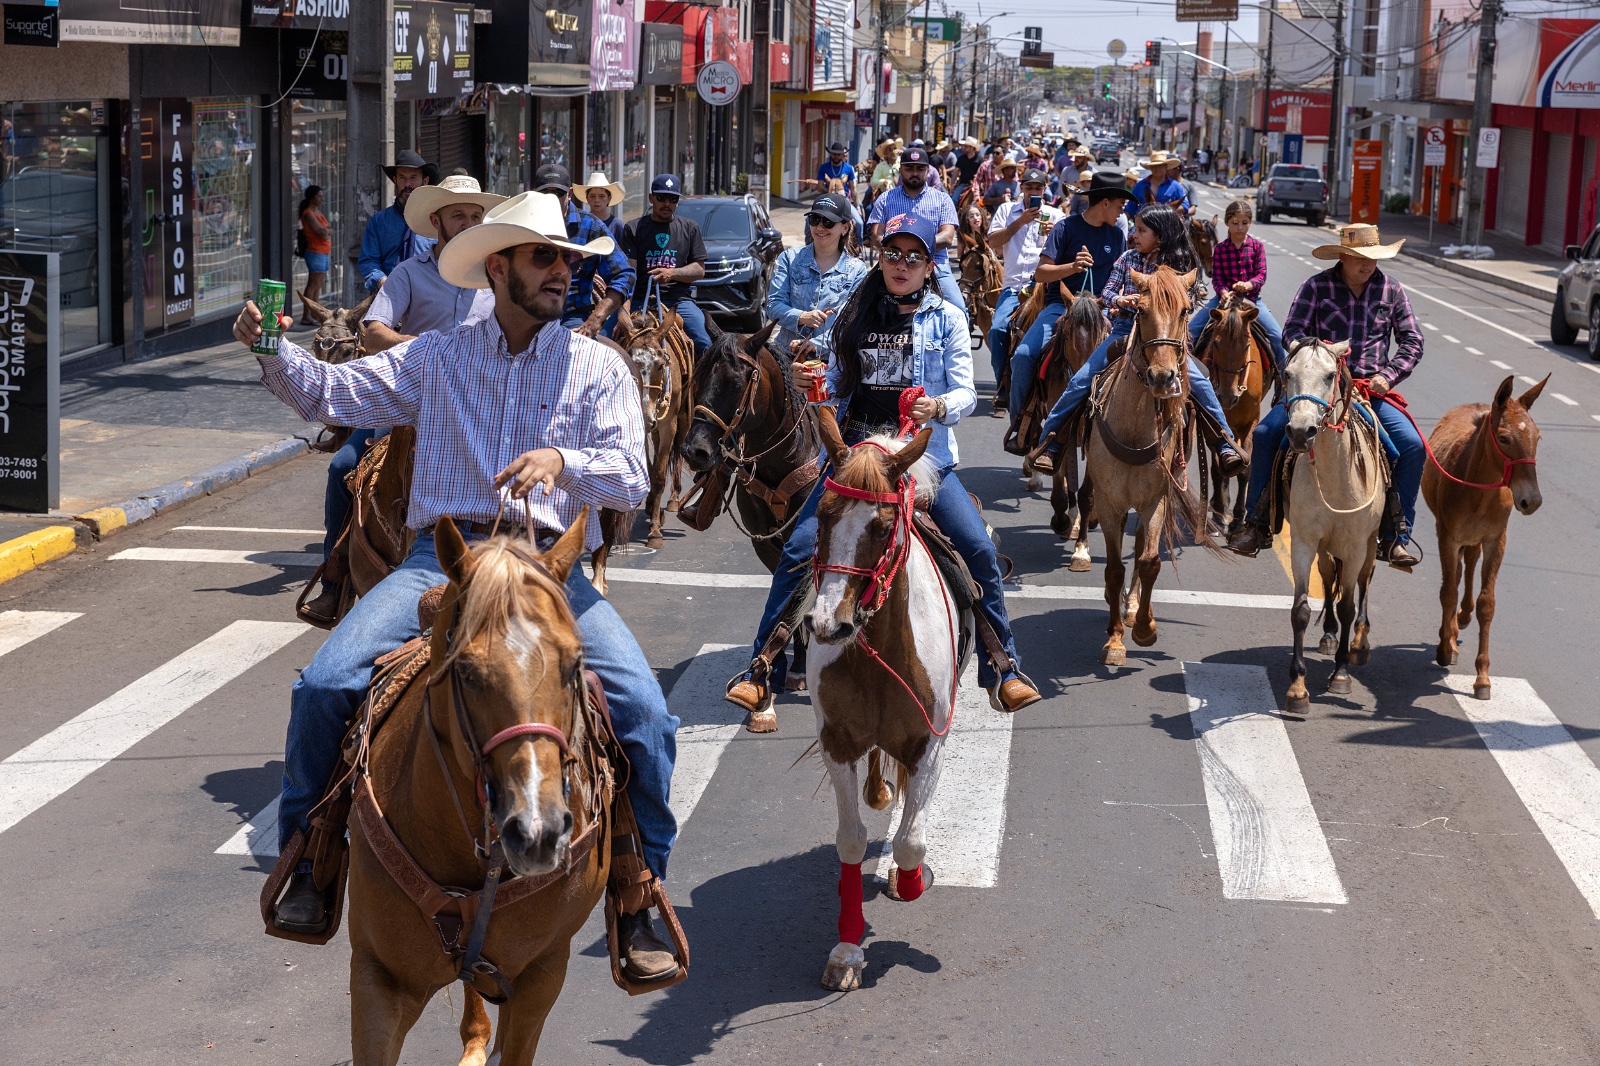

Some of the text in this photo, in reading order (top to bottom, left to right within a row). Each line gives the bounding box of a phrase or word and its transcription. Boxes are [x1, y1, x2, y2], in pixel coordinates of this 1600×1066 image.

[295, 0, 350, 19] ASHION
[5, 18, 48, 33] Suporte
[394, 11, 410, 53] GF
[702, 76, 735, 86] MICRO
[1486, 133, 1493, 142] E
[1361, 172, 1372, 206] Suvinil
[171, 113, 186, 297] FASHION
[645, 249, 678, 257] ARIAT
[645, 256, 677, 269] TEXAS
[166, 298, 193, 316] CONCEPT
[11, 309, 26, 377] SMART
[862, 332, 914, 345] OWGI
[877, 342, 904, 350] STYLE
[0, 456, 38, 468] 03-7493
[0, 468, 37, 480] 07-9001
